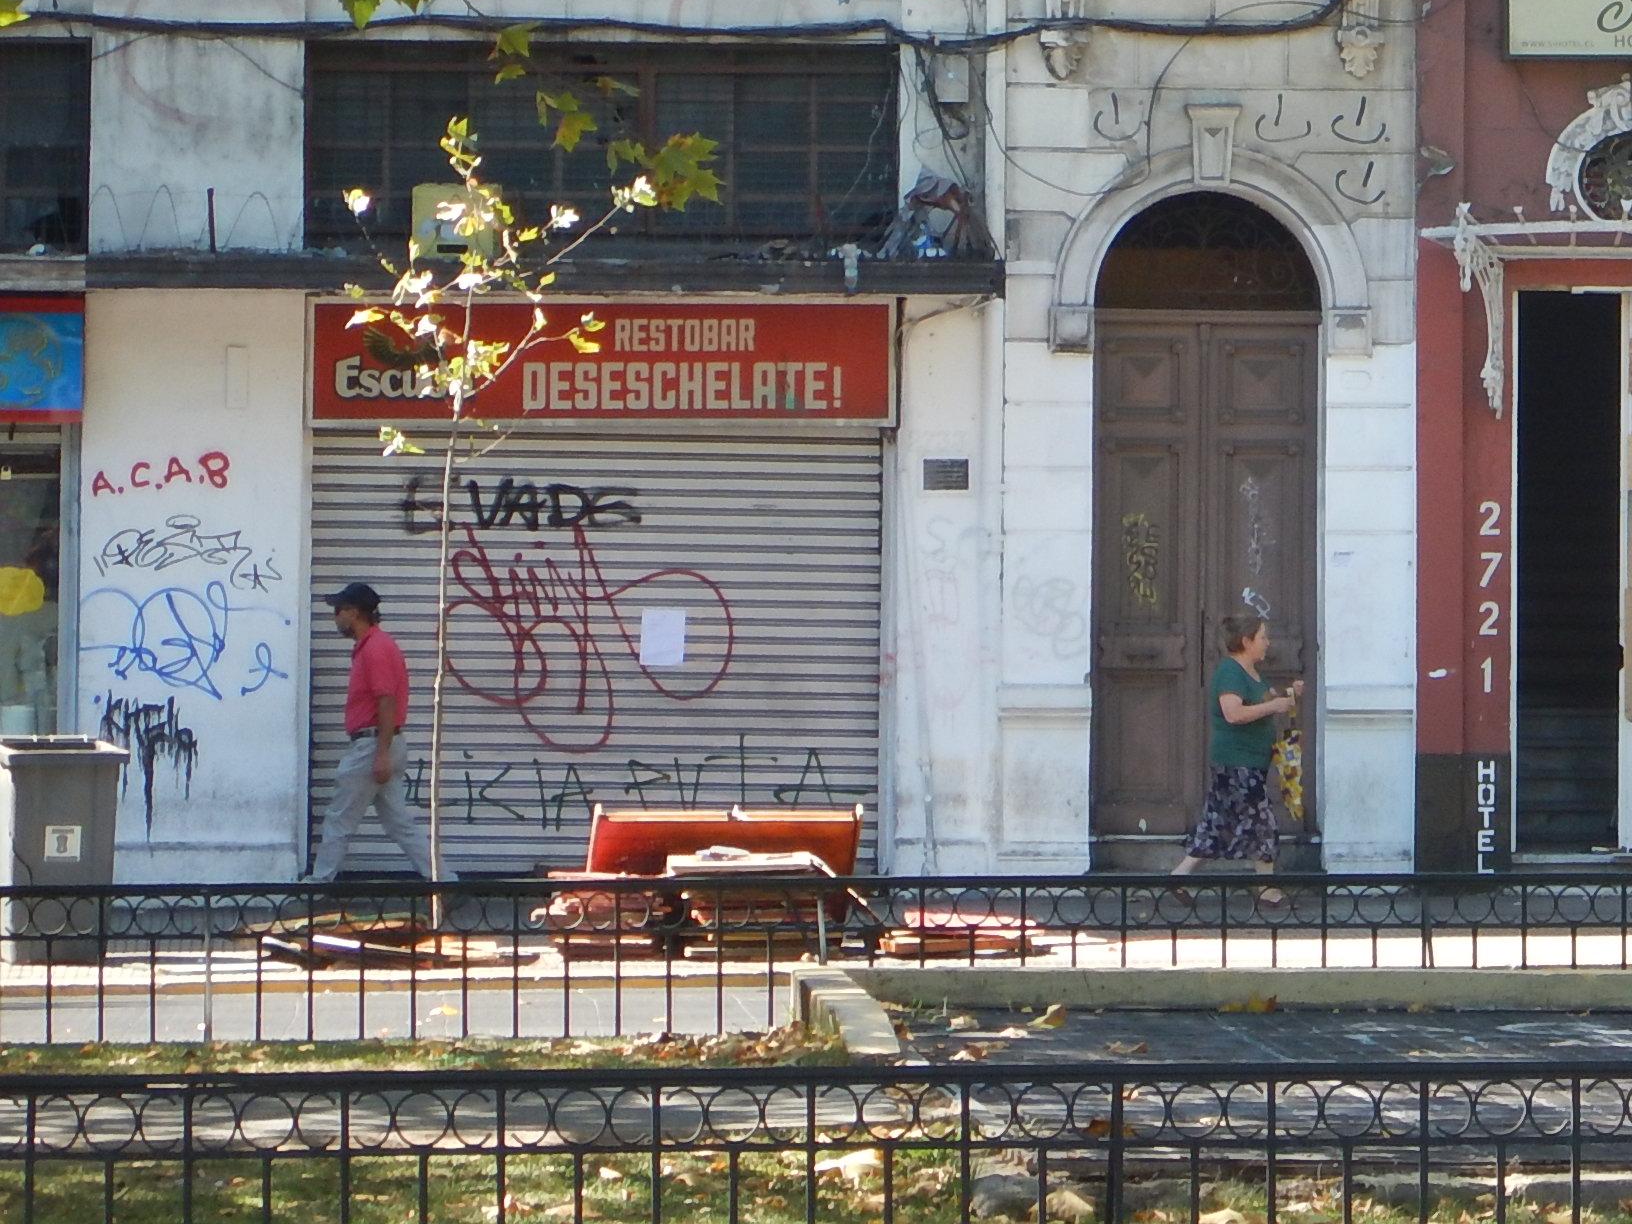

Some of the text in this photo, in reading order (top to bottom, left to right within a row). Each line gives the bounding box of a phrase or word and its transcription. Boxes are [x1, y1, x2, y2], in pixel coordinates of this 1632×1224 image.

[614, 318, 756, 353] RESTOBAR
[334, 355, 474, 399] Escu
[522, 361, 842, 411] DESESCHELATE!
[1476, 761, 1495, 874] HOTEL
